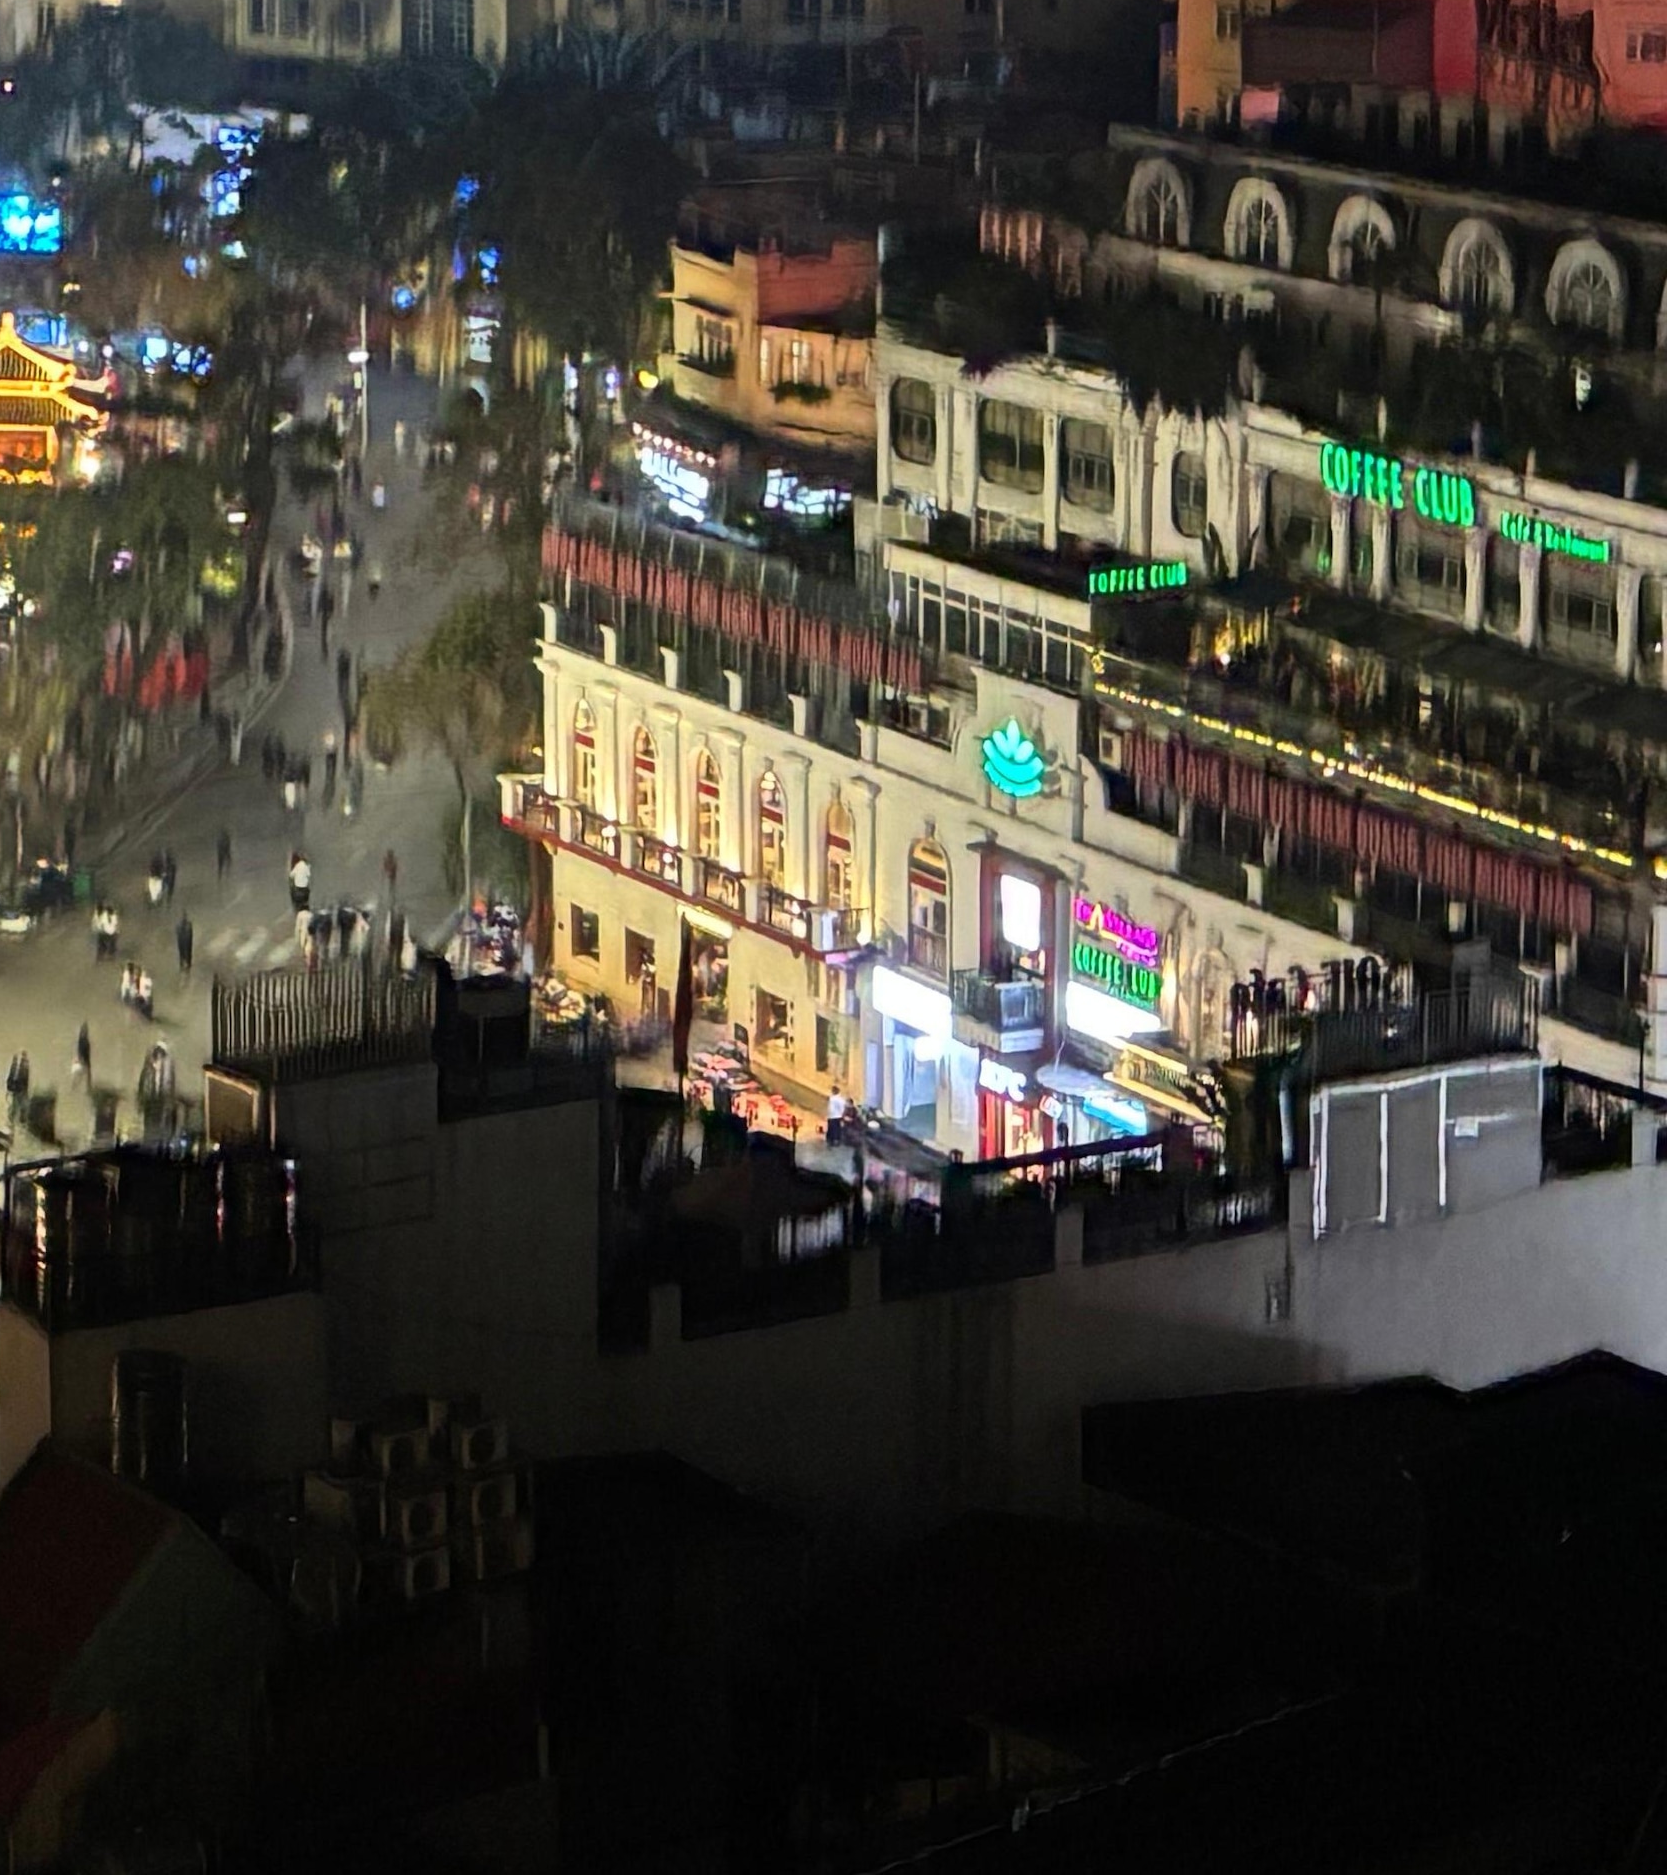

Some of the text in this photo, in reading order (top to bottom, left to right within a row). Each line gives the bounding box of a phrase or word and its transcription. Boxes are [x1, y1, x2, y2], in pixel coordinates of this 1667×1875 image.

[1321, 441, 1475, 527] COFFEE CLUB
[1125, 963, 1158, 1000] LUB
